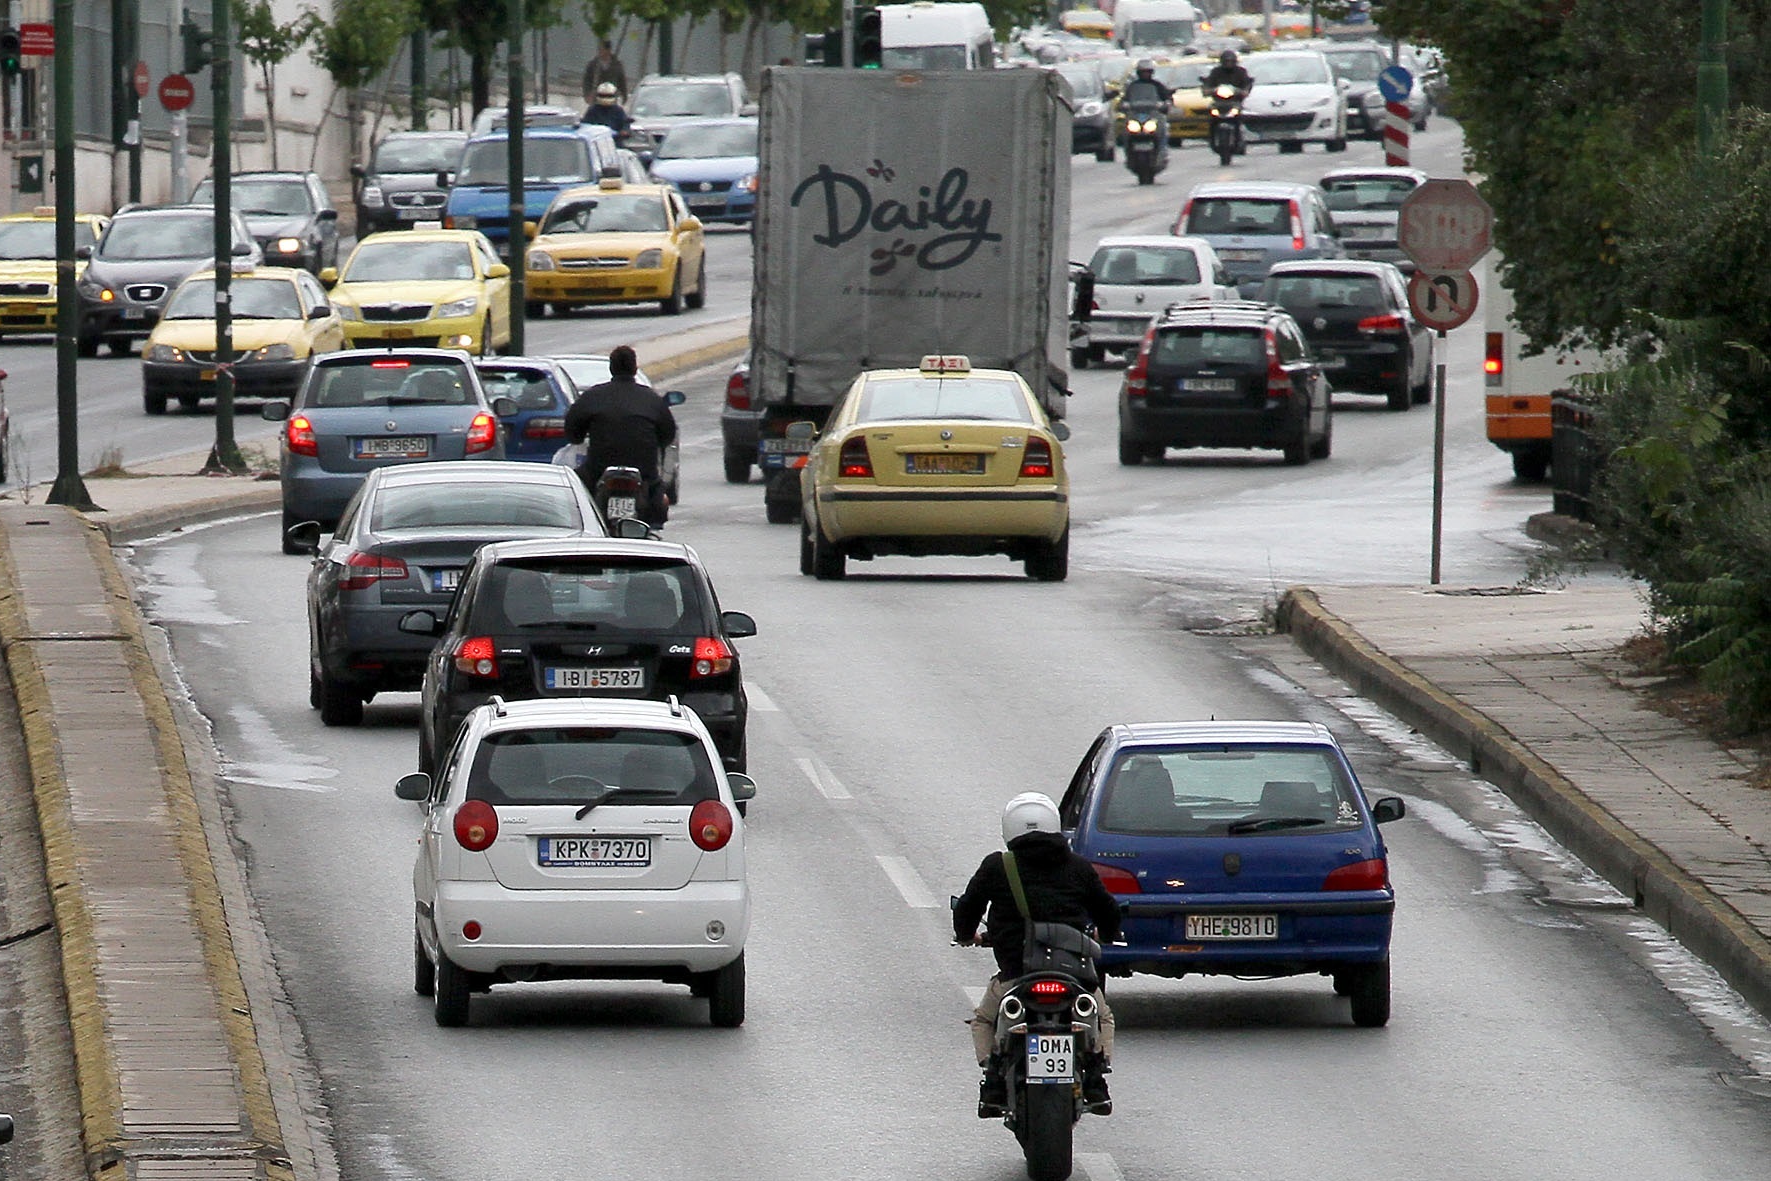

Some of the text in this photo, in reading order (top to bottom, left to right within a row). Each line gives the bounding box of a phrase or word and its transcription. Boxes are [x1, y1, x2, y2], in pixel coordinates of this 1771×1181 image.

[791, 164, 1002, 270] Daily
[1406, 204, 1487, 249] STOP
[556, 841, 646, 859] KPK-7370
[1191, 917, 1275, 936] YHE-9810
[1040, 1039, 1072, 1054] OMA
[1045, 1058, 1066, 1073] 93
